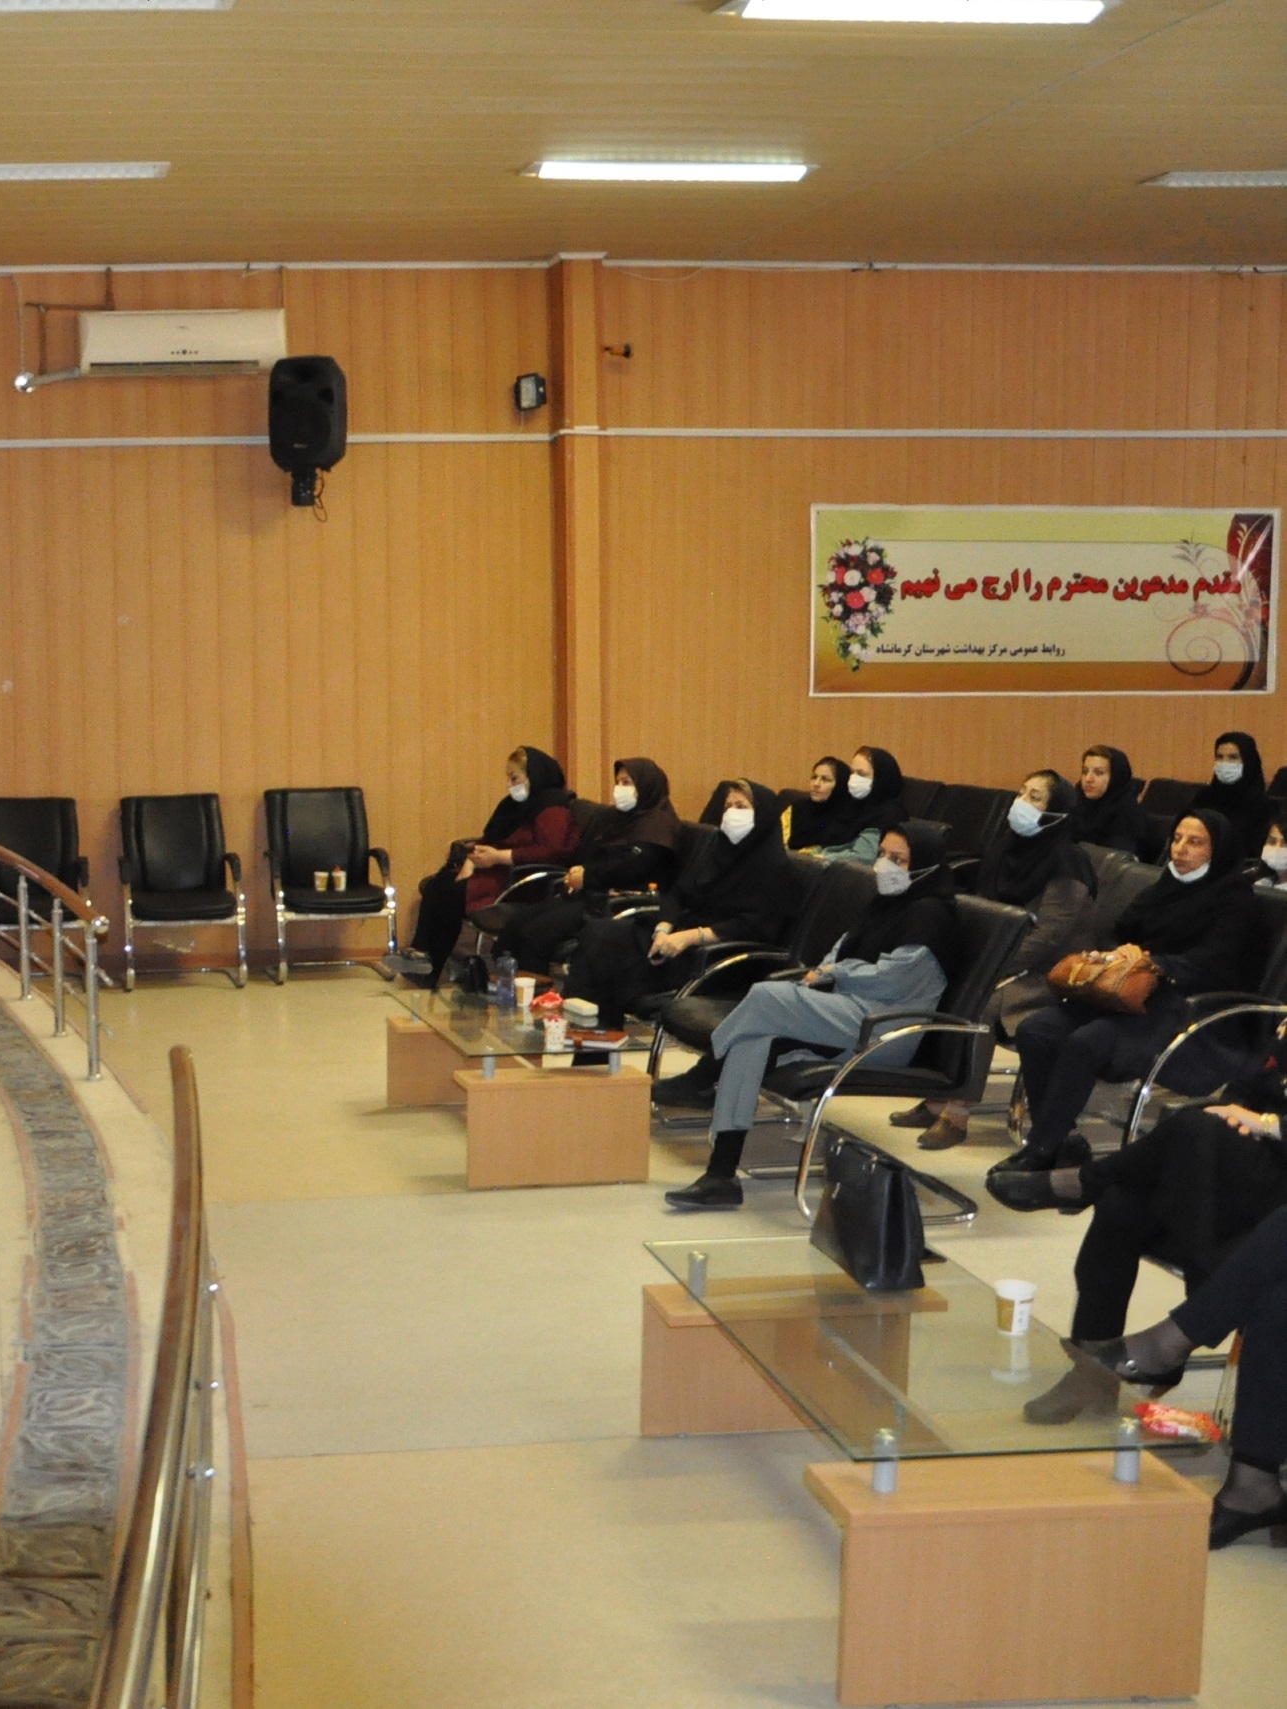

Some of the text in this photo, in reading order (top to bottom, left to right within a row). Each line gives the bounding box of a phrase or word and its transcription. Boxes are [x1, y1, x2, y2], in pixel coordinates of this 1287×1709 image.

[900, 567, 1242, 602] مقدم مدعوین محترم را ارج می نهیم
[876, 642, 1066, 657] روابط عمومی مرکز بهداشت شهرستان کرمانشاه
